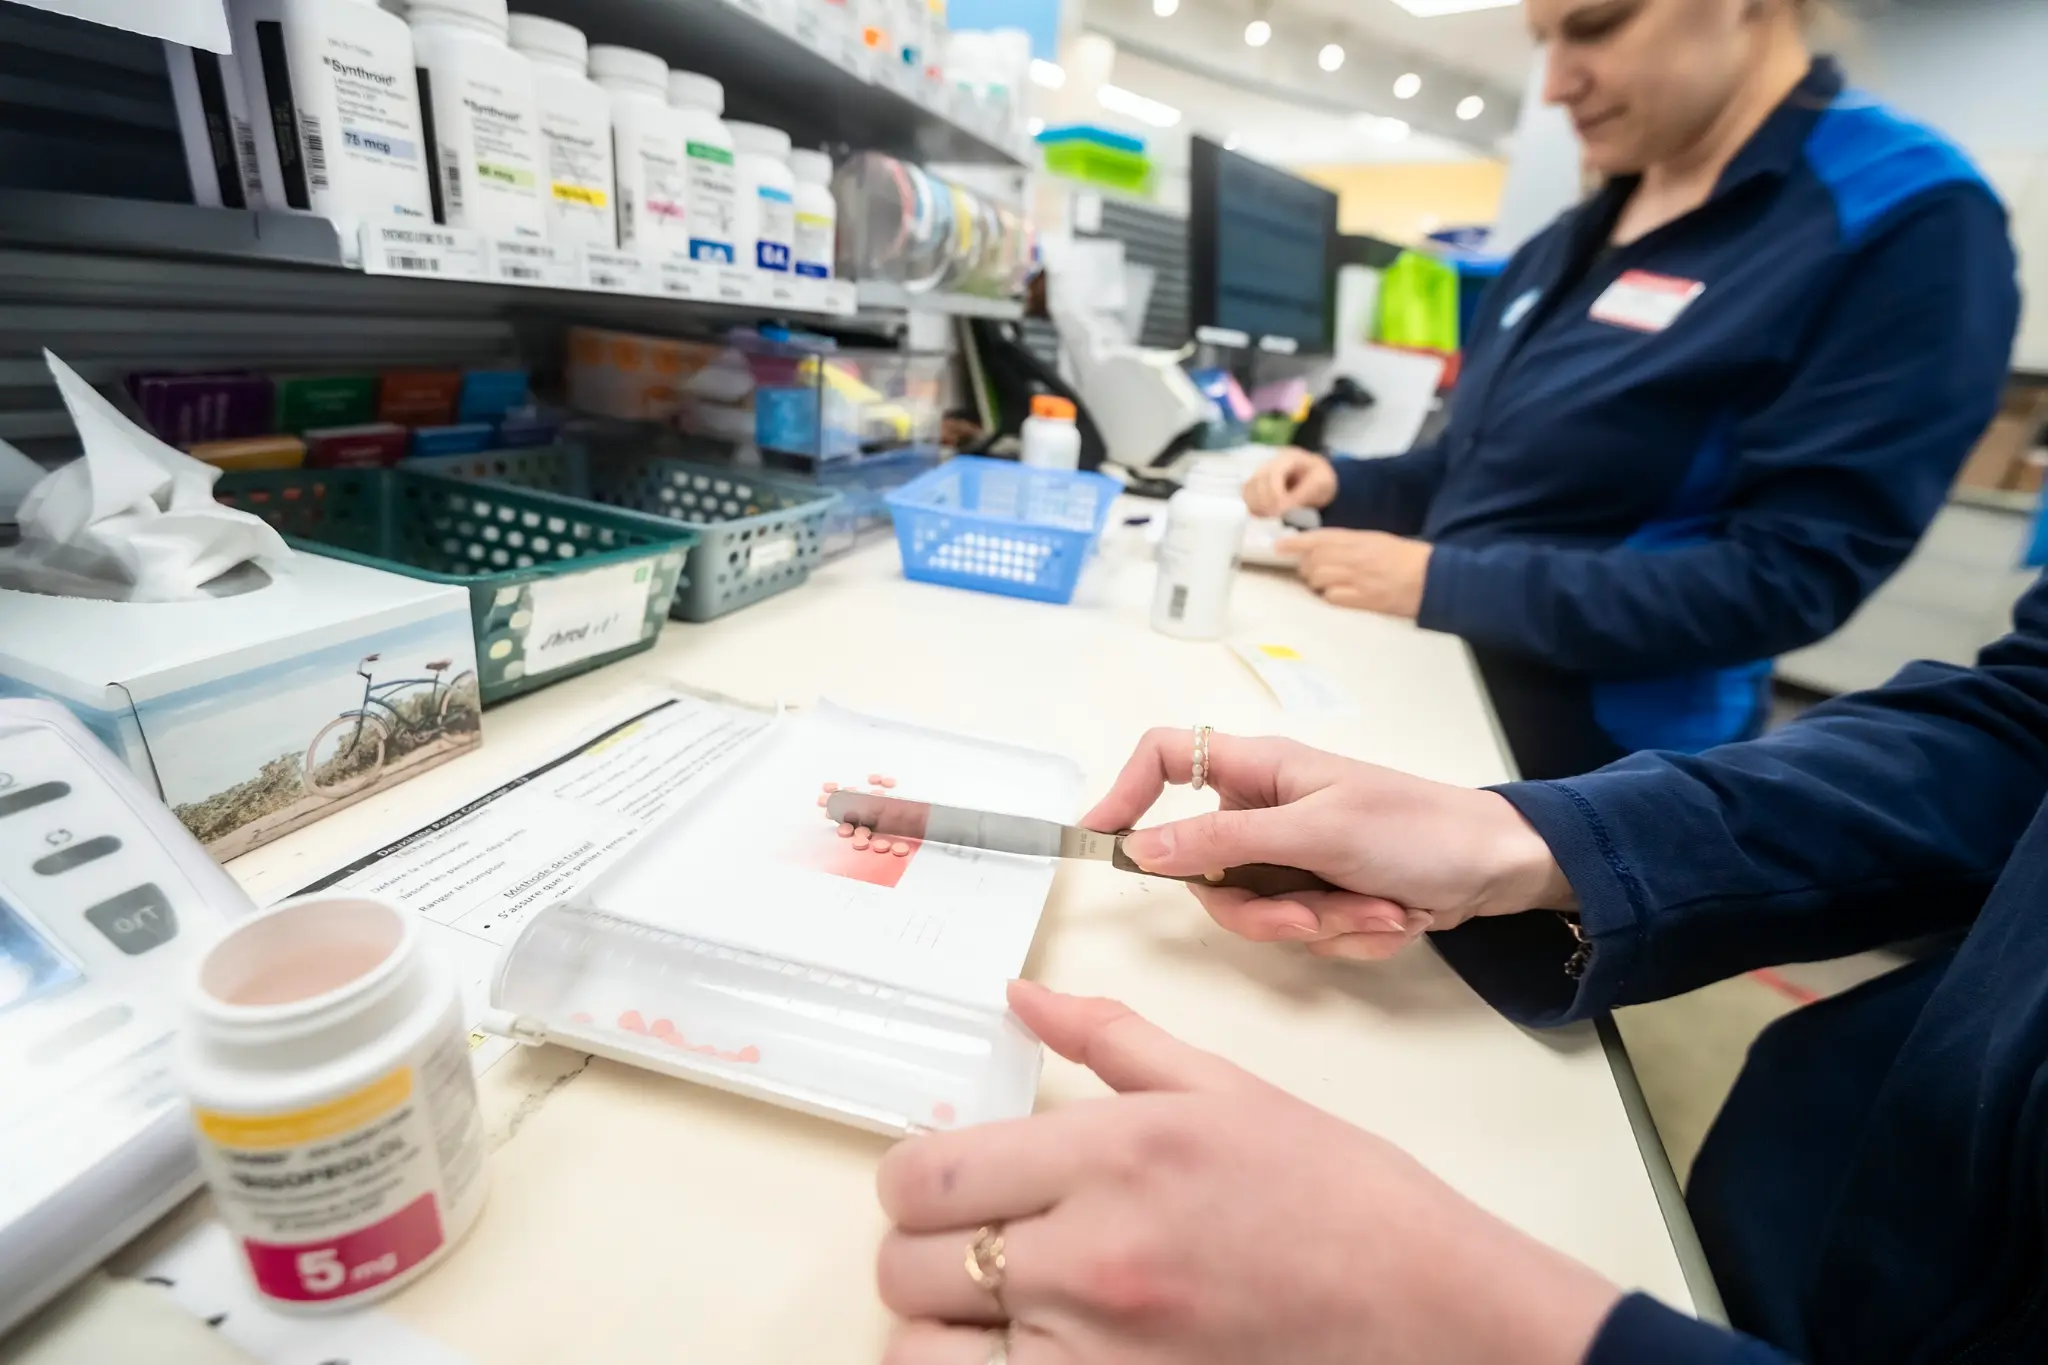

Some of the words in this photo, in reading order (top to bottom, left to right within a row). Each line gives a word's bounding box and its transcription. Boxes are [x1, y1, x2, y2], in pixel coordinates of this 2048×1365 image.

[331, 58, 393, 87] Synthroid
[497, 888, 543, 920] S'assure
[542, 876, 563, 892] que
[572, 849, 603, 873] panier
[503, 864, 551, 899] Méthode
[550, 858, 565, 872] de
[563, 840, 596, 863] travail
[418, 889, 455, 914] Ranger
[295, 1247, 346, 1294] 5
[349, 1251, 398, 1282] mg
